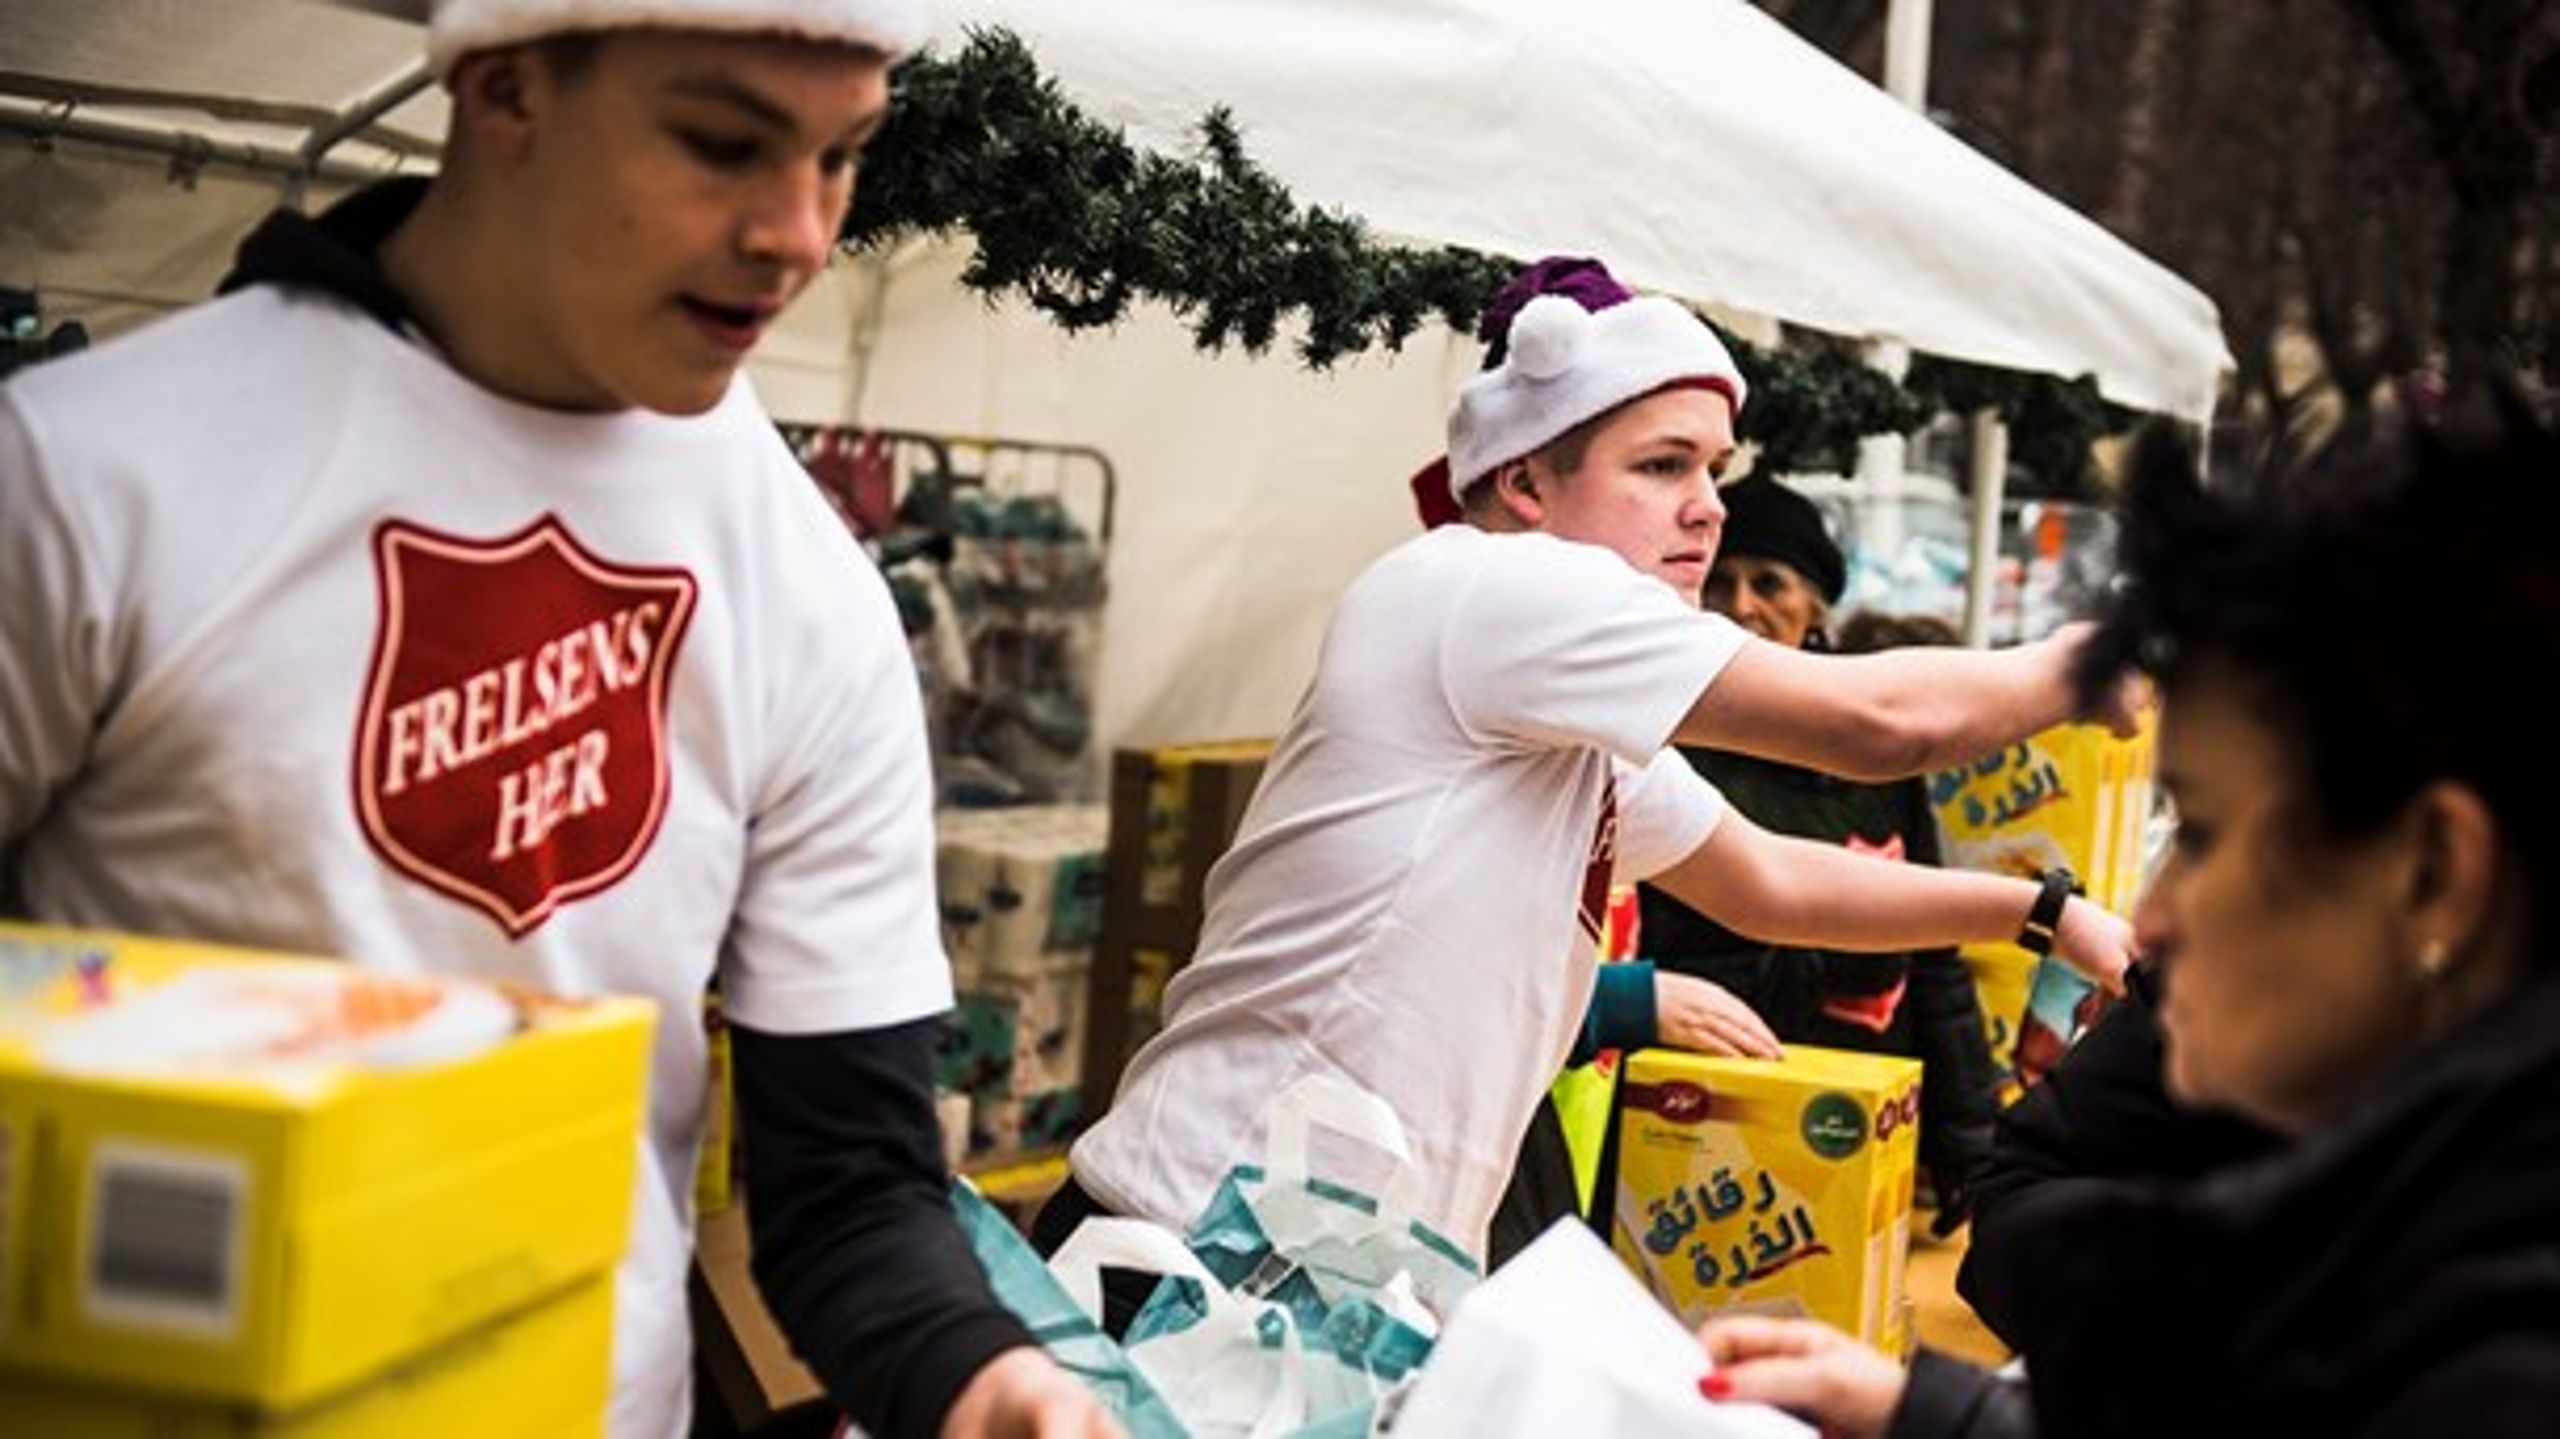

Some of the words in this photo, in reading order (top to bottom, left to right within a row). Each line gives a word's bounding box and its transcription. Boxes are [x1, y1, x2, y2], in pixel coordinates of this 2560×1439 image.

[382, 601, 660, 795] FRELSENS
[490, 729, 609, 861] HER
[1645, 1166, 1776, 1255] رقائق
[1687, 1205, 1814, 1288] الذرة
